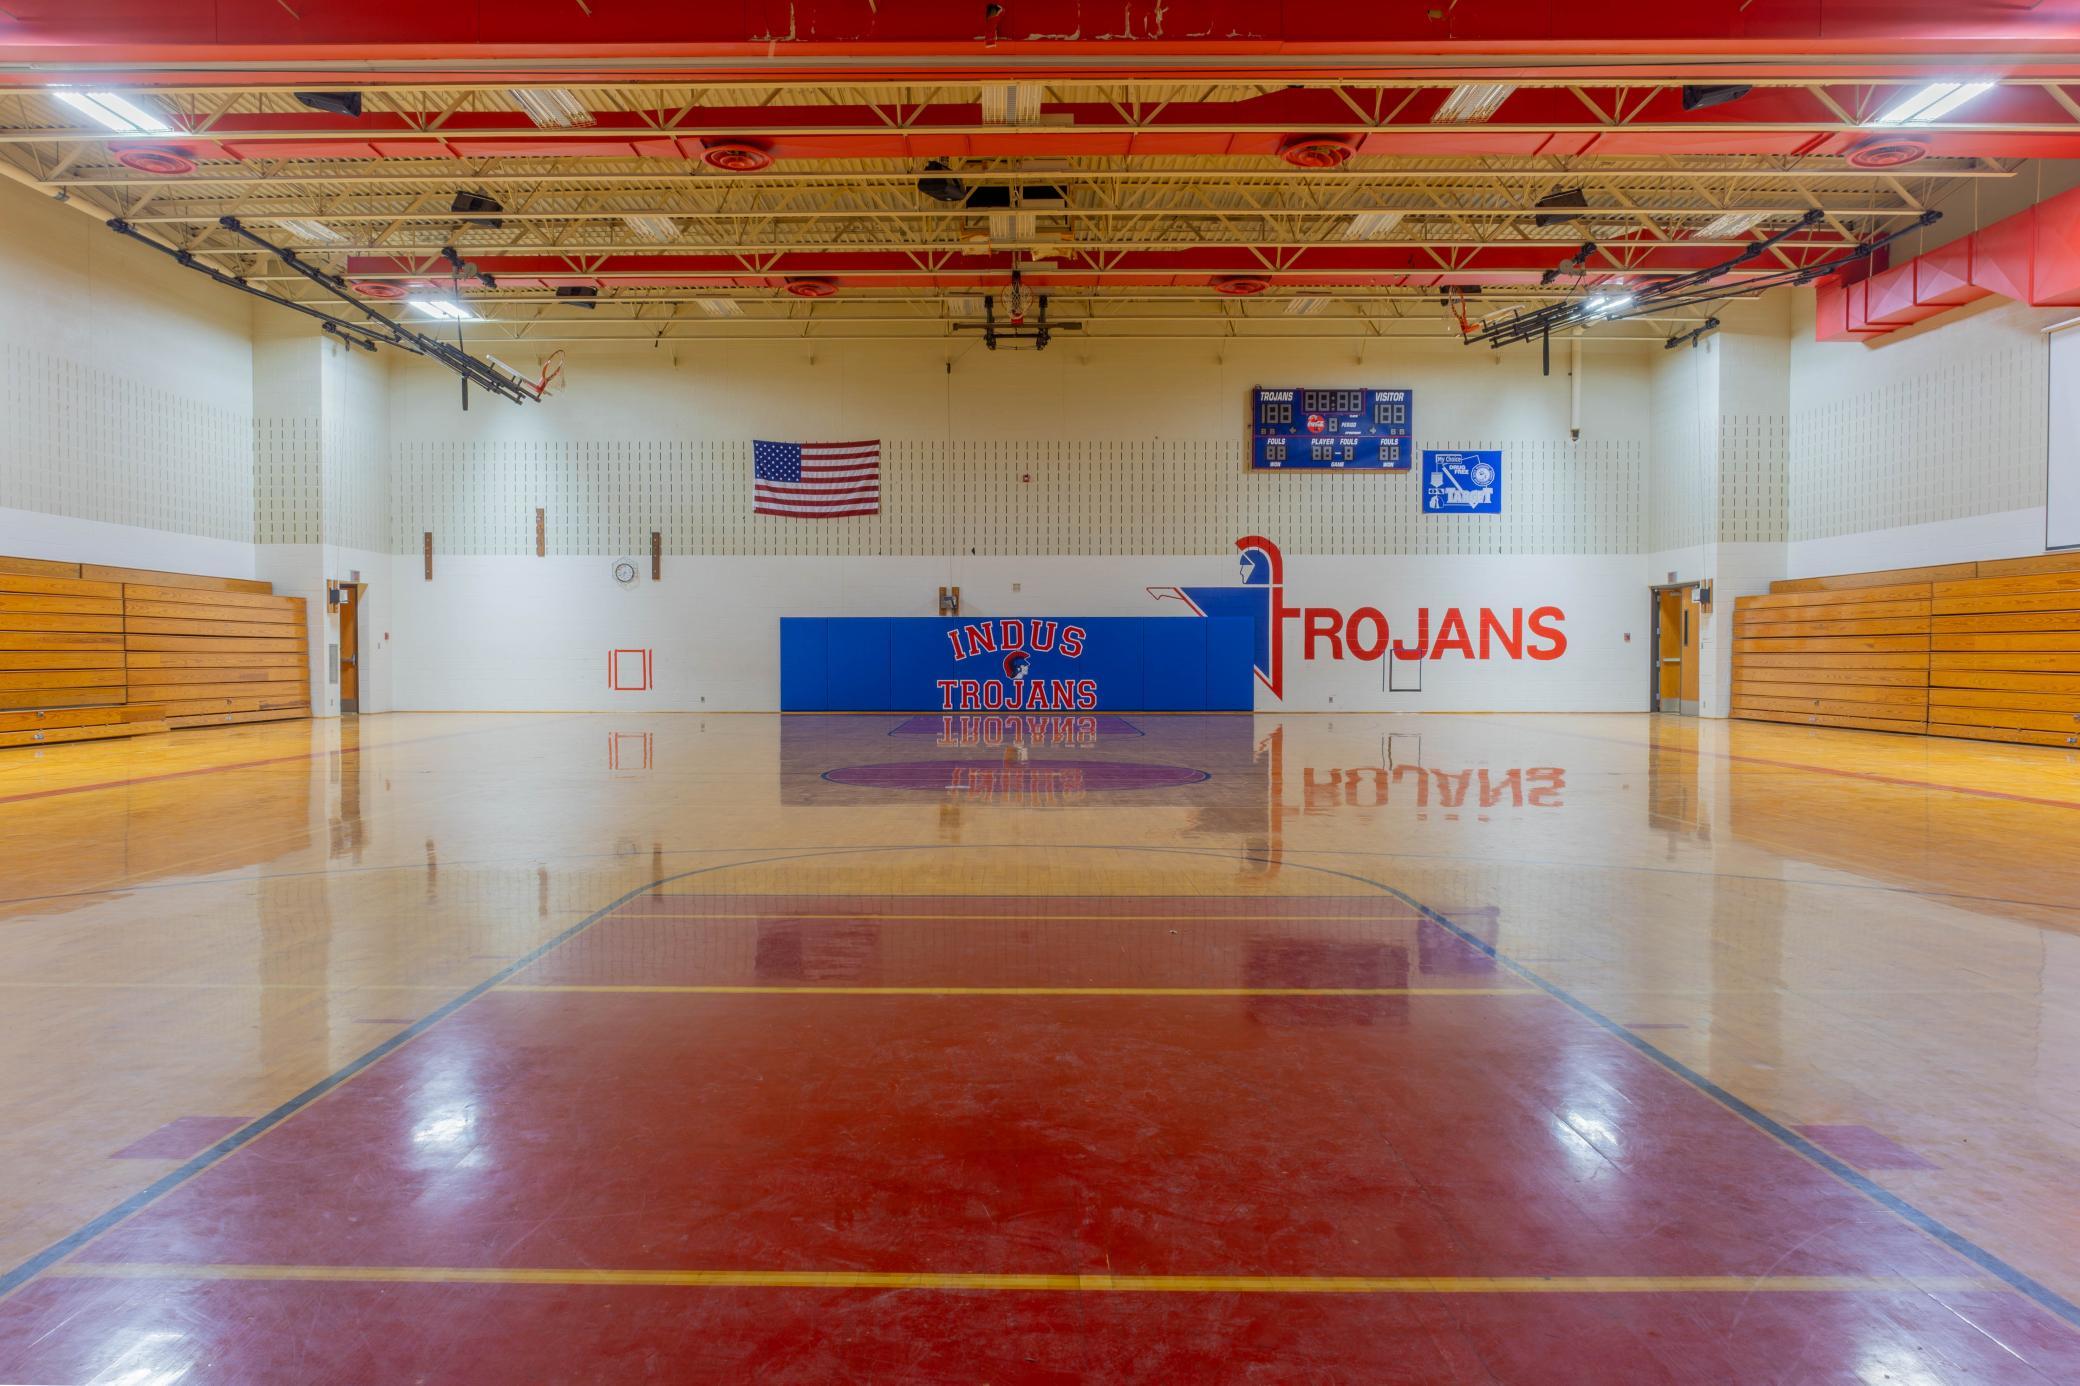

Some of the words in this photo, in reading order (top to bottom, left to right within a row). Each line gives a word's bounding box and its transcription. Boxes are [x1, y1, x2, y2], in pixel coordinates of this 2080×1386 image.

[1260, 391, 1294, 401] TROJANS
[1375, 392, 1405, 402] VISITOR
[947, 618, 1087, 662] INDUS
[936, 679, 1098, 710] TROJANS
